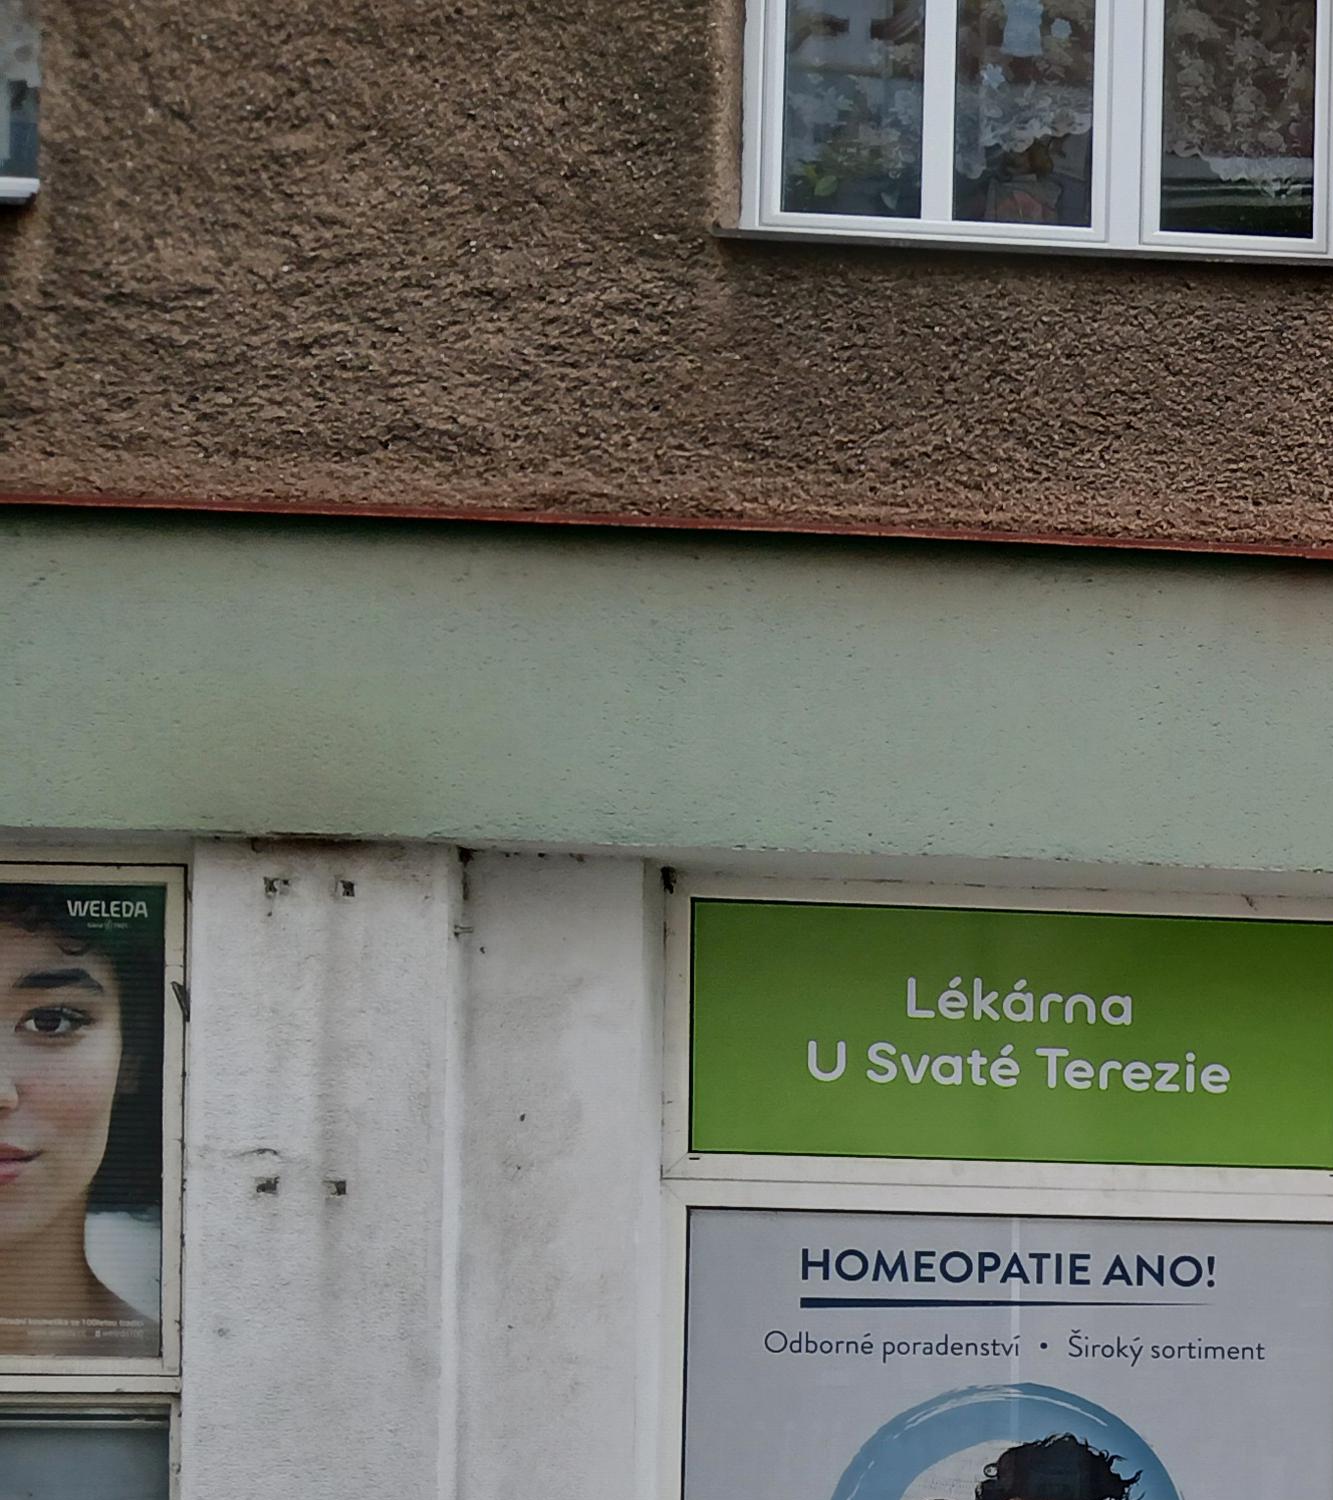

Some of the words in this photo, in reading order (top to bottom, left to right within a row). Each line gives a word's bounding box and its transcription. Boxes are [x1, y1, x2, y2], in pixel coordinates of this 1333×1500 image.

[66, 899, 148, 918] WELEDA
[906, 976, 1133, 1026] Lékárna
[807, 1040, 847, 1082] U
[866, 1043, 1021, 1087] Svaté
[1035, 1047, 1231, 1094] Terezie
[800, 1247, 1092, 1286] HOMEOPATIE
[1102, 1254, 1217, 1289] ANO!
[764, 1329, 875, 1355] Odborné
[882, 1333, 1021, 1364] poradenství
[1068, 1329, 1144, 1367] Široký
[1150, 1336, 1266, 1361] sortiment
